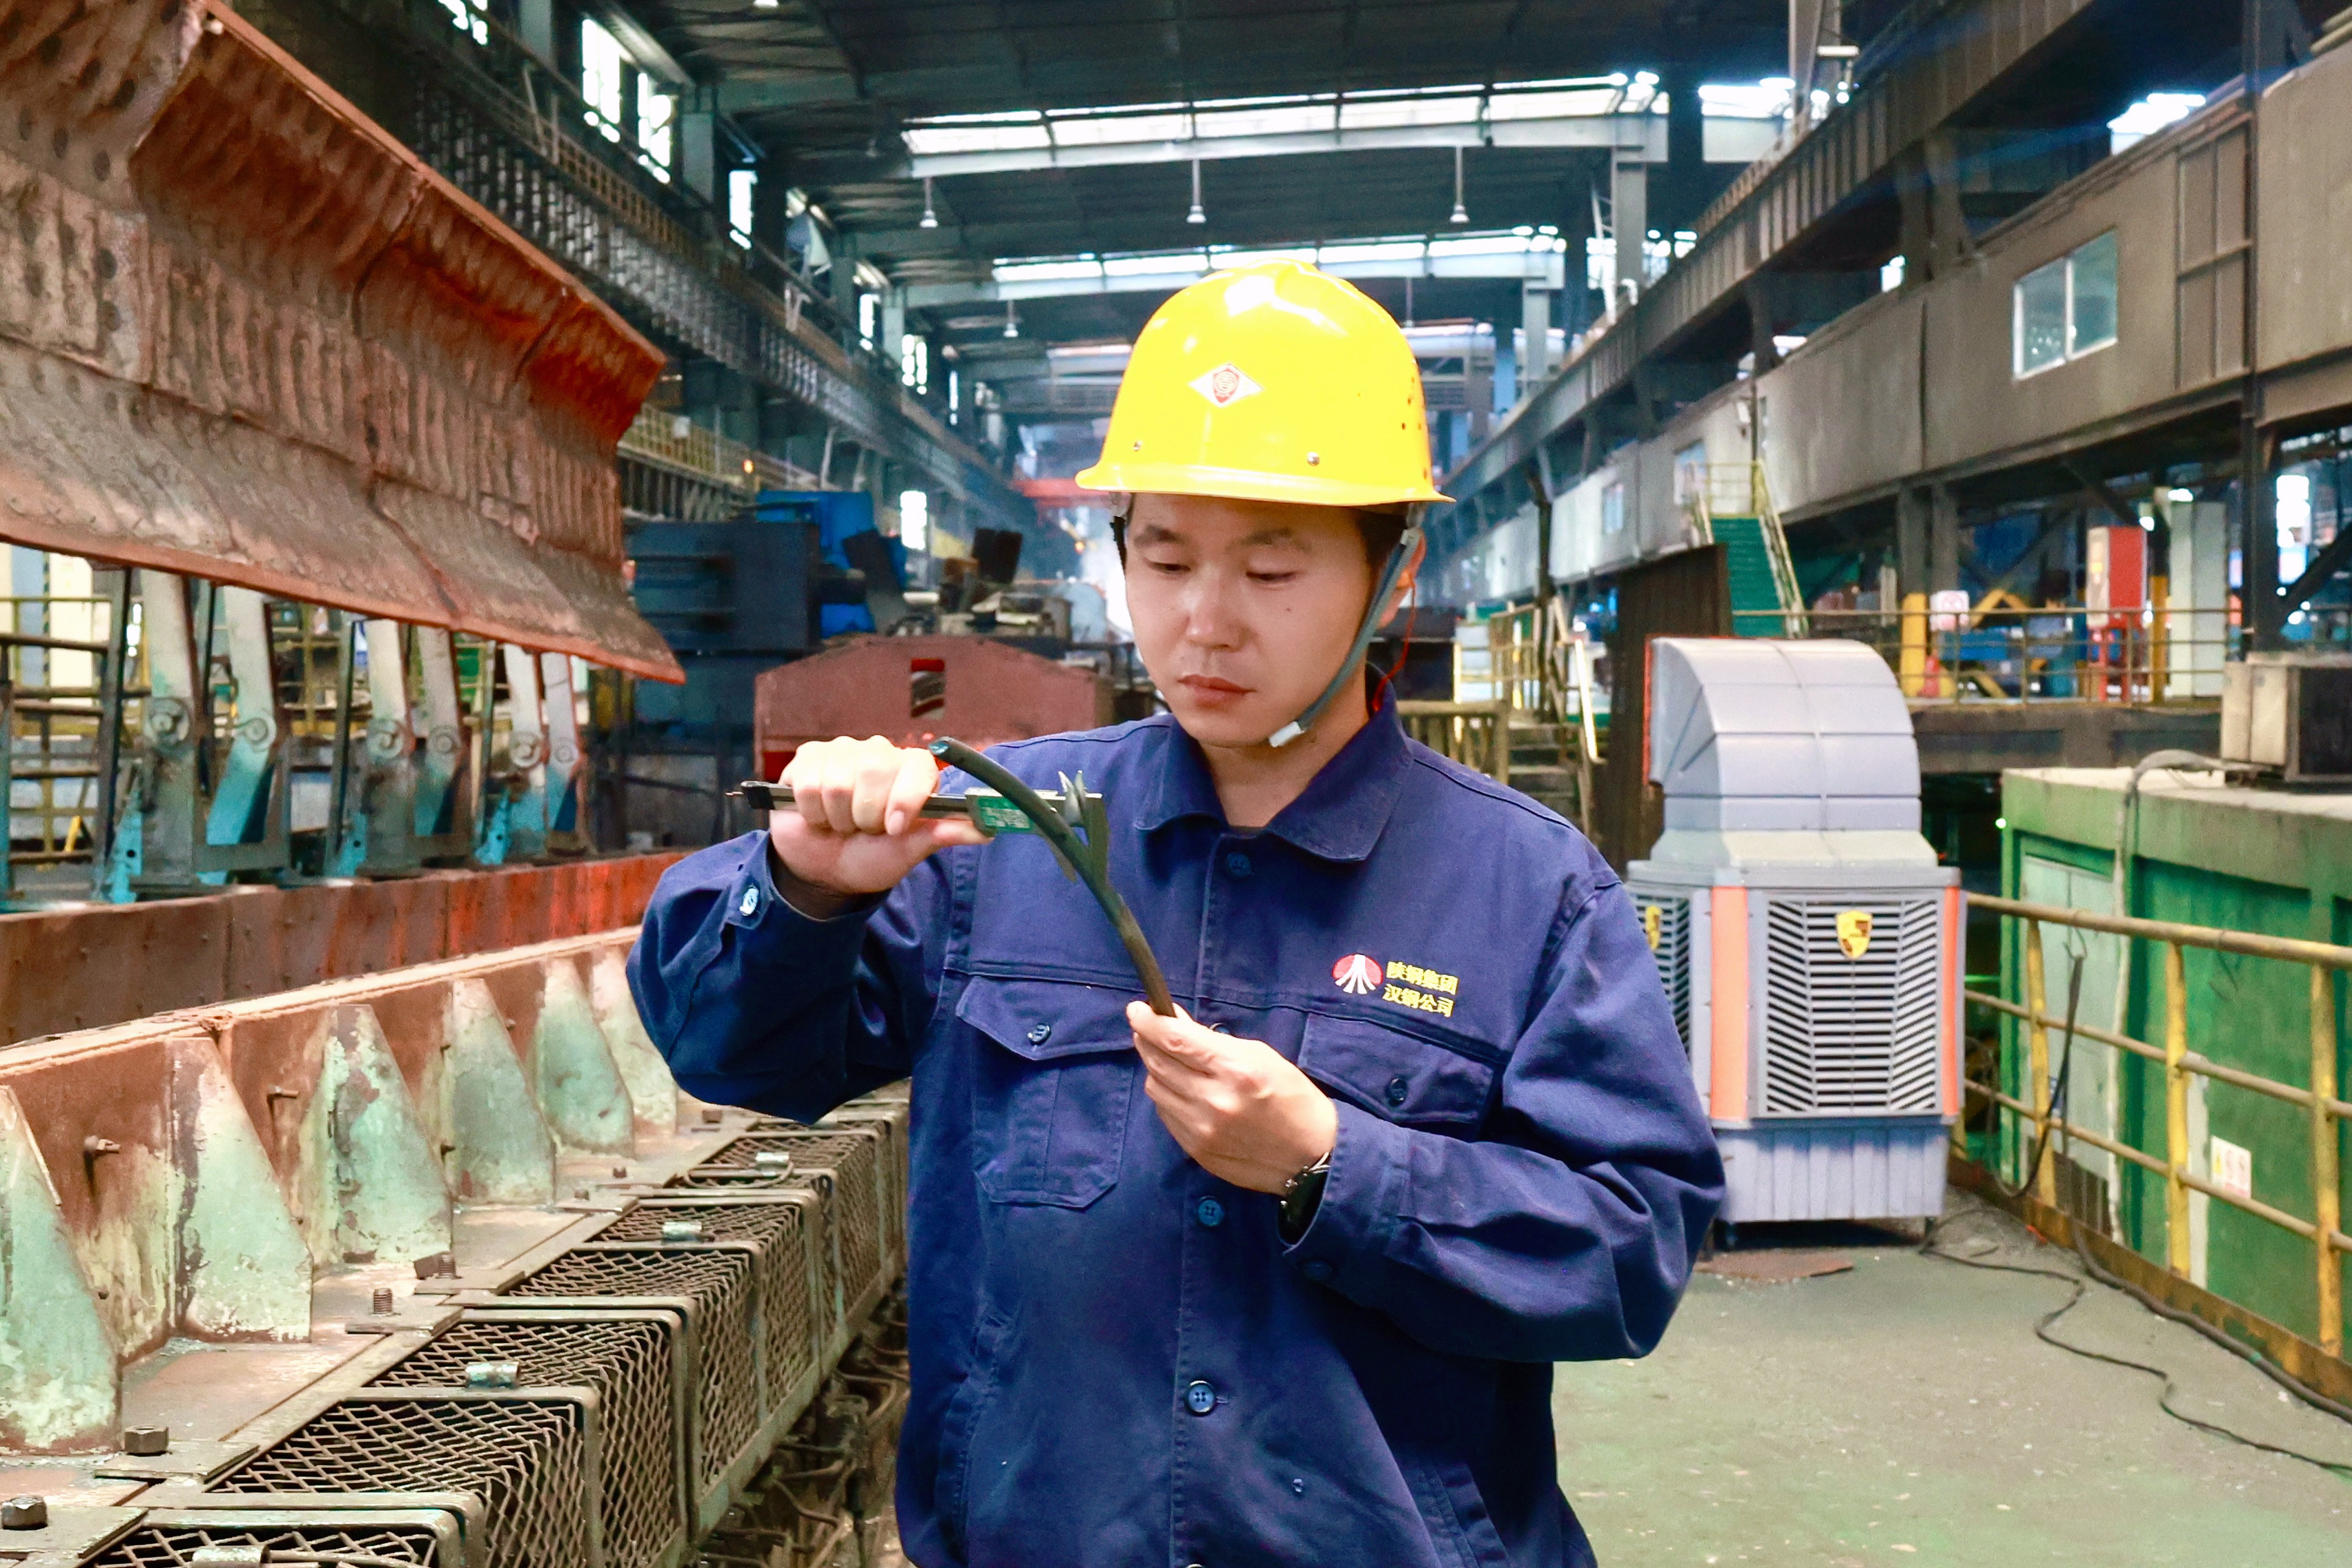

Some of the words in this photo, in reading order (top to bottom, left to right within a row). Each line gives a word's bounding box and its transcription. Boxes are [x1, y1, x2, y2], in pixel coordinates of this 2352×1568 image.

[1386, 962, 1458, 994] 陕钢集团
[1383, 984, 1453, 1017] 汉钢公司
